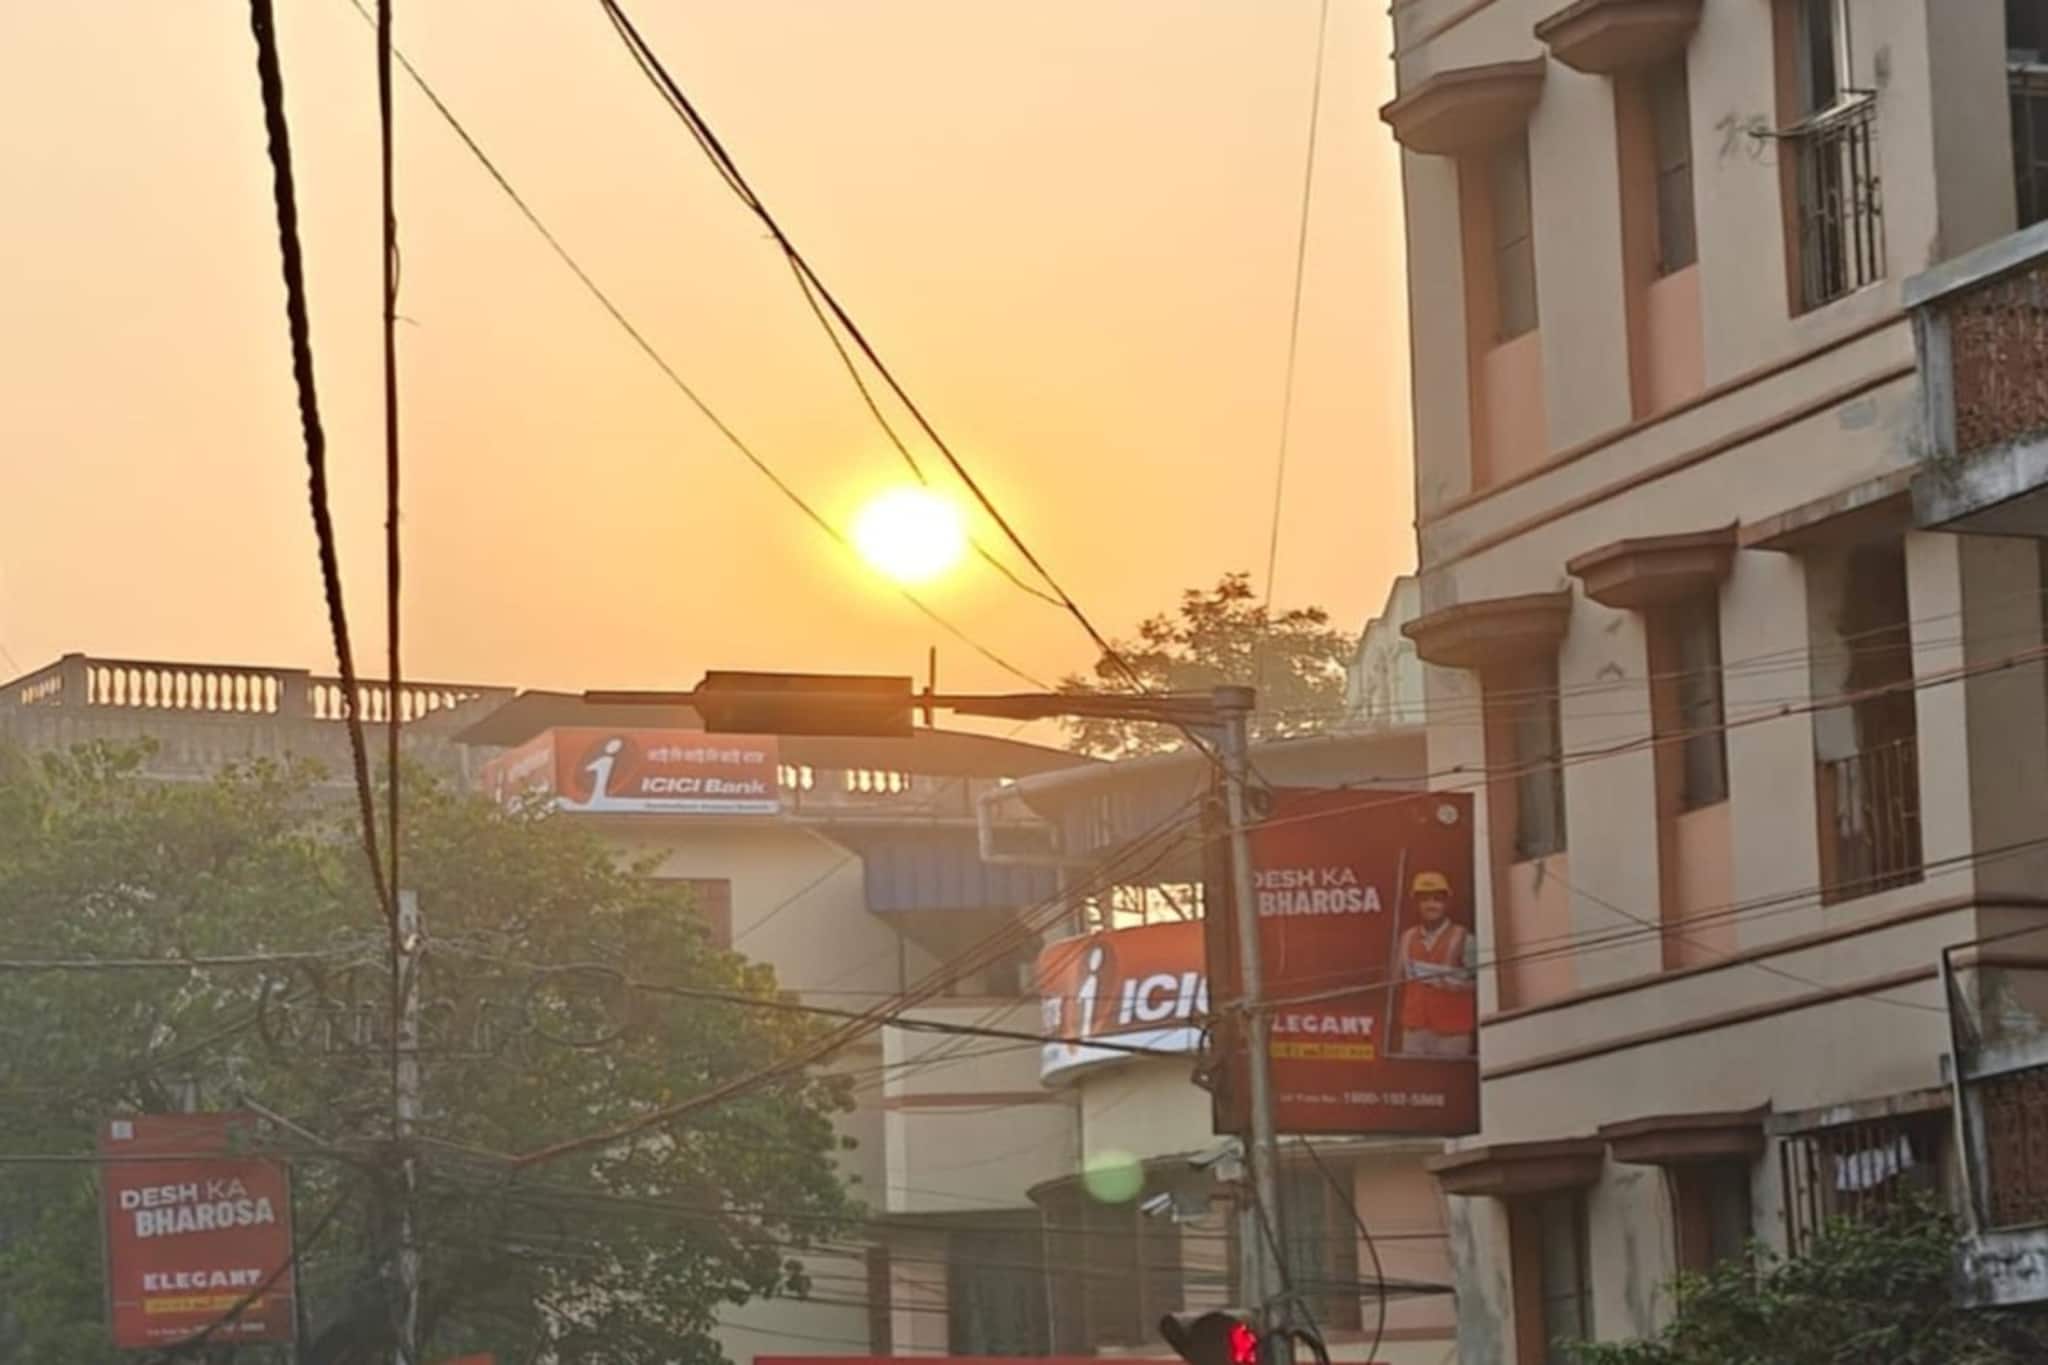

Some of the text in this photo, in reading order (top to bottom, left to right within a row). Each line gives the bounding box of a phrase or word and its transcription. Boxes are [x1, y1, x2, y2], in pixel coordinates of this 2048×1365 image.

[641, 777, 768, 794] ICICI Bank
[1321, 867, 1357, 887] KA
[1259, 886, 1381, 917] BHAROSA
[1119, 971, 1209, 1025] ICI
[1271, 1015, 1374, 1036] LEGANT
[119, 1178, 249, 1210] DESH KA
[135, 1196, 276, 1238] BHAROSA
[143, 1268, 262, 1292] ELEGANT
